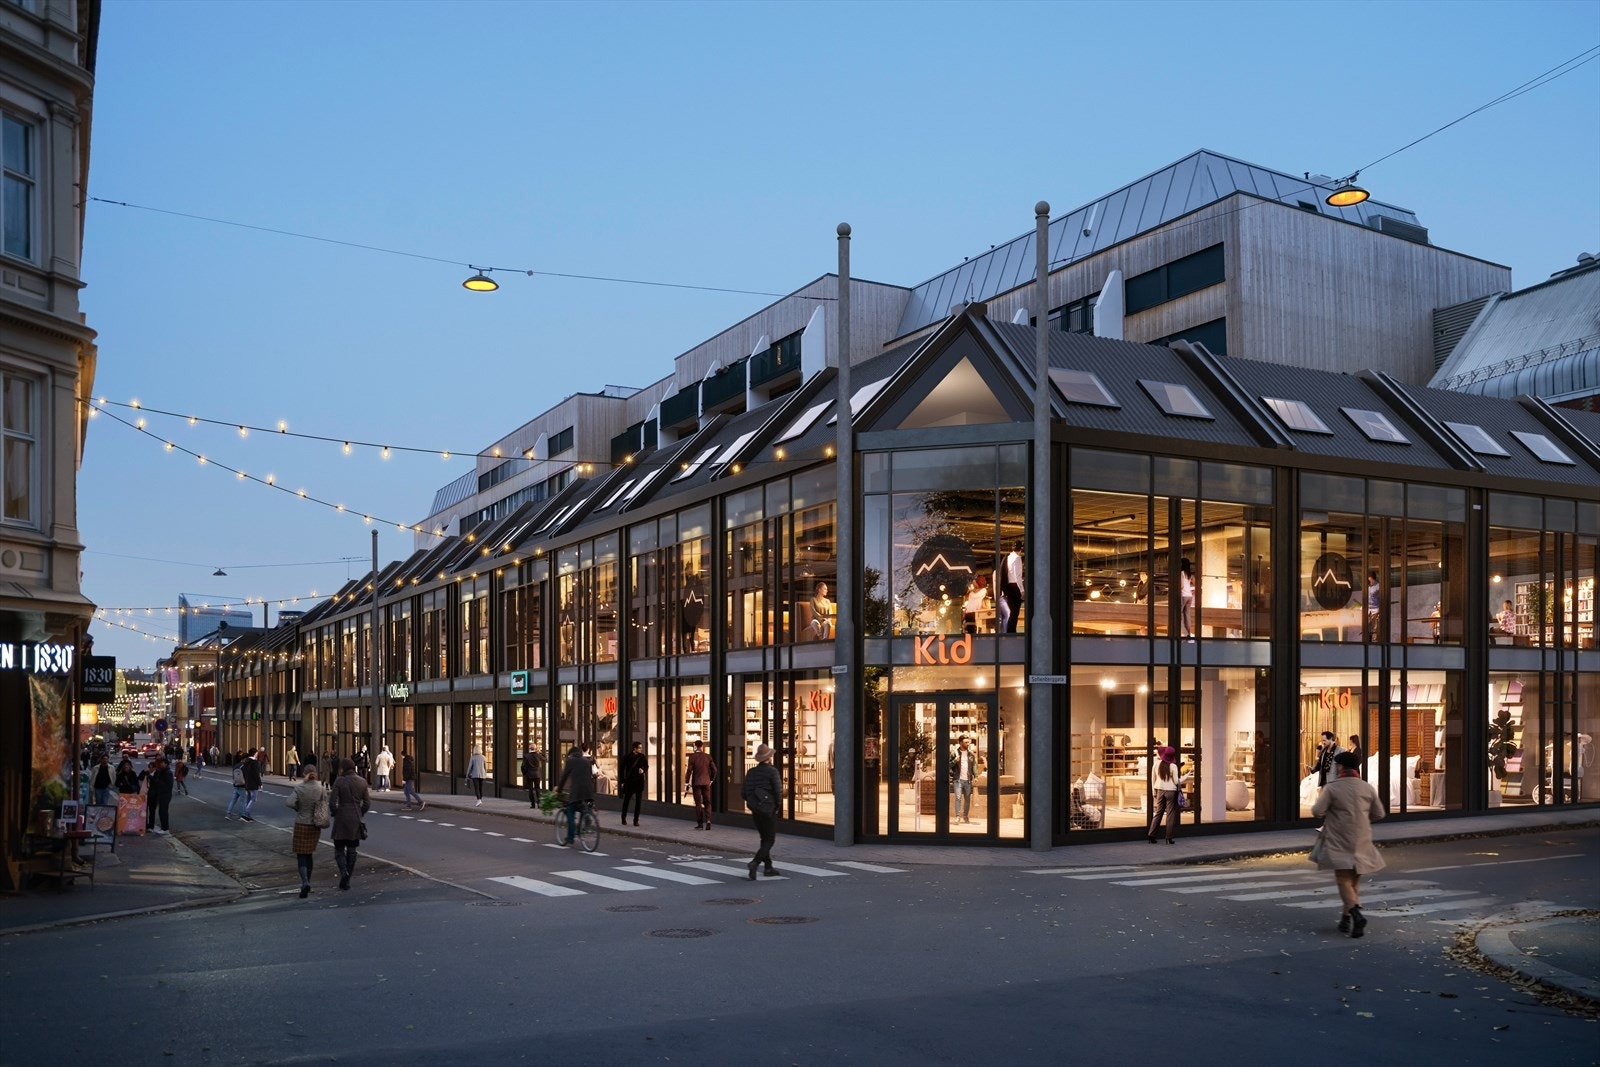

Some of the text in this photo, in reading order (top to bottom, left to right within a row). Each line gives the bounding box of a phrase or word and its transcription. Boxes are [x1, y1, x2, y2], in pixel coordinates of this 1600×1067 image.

[0, 643, 14, 669] N
[34, 643, 75, 674] 1830
[914, 633, 973, 665] Kid
[84, 667, 113, 683] 1830
[604, 696, 617, 714] Kid
[688, 693, 705, 713] Kid
[808, 689, 832, 712] Kid
[1319, 687, 1352, 711] Kid
